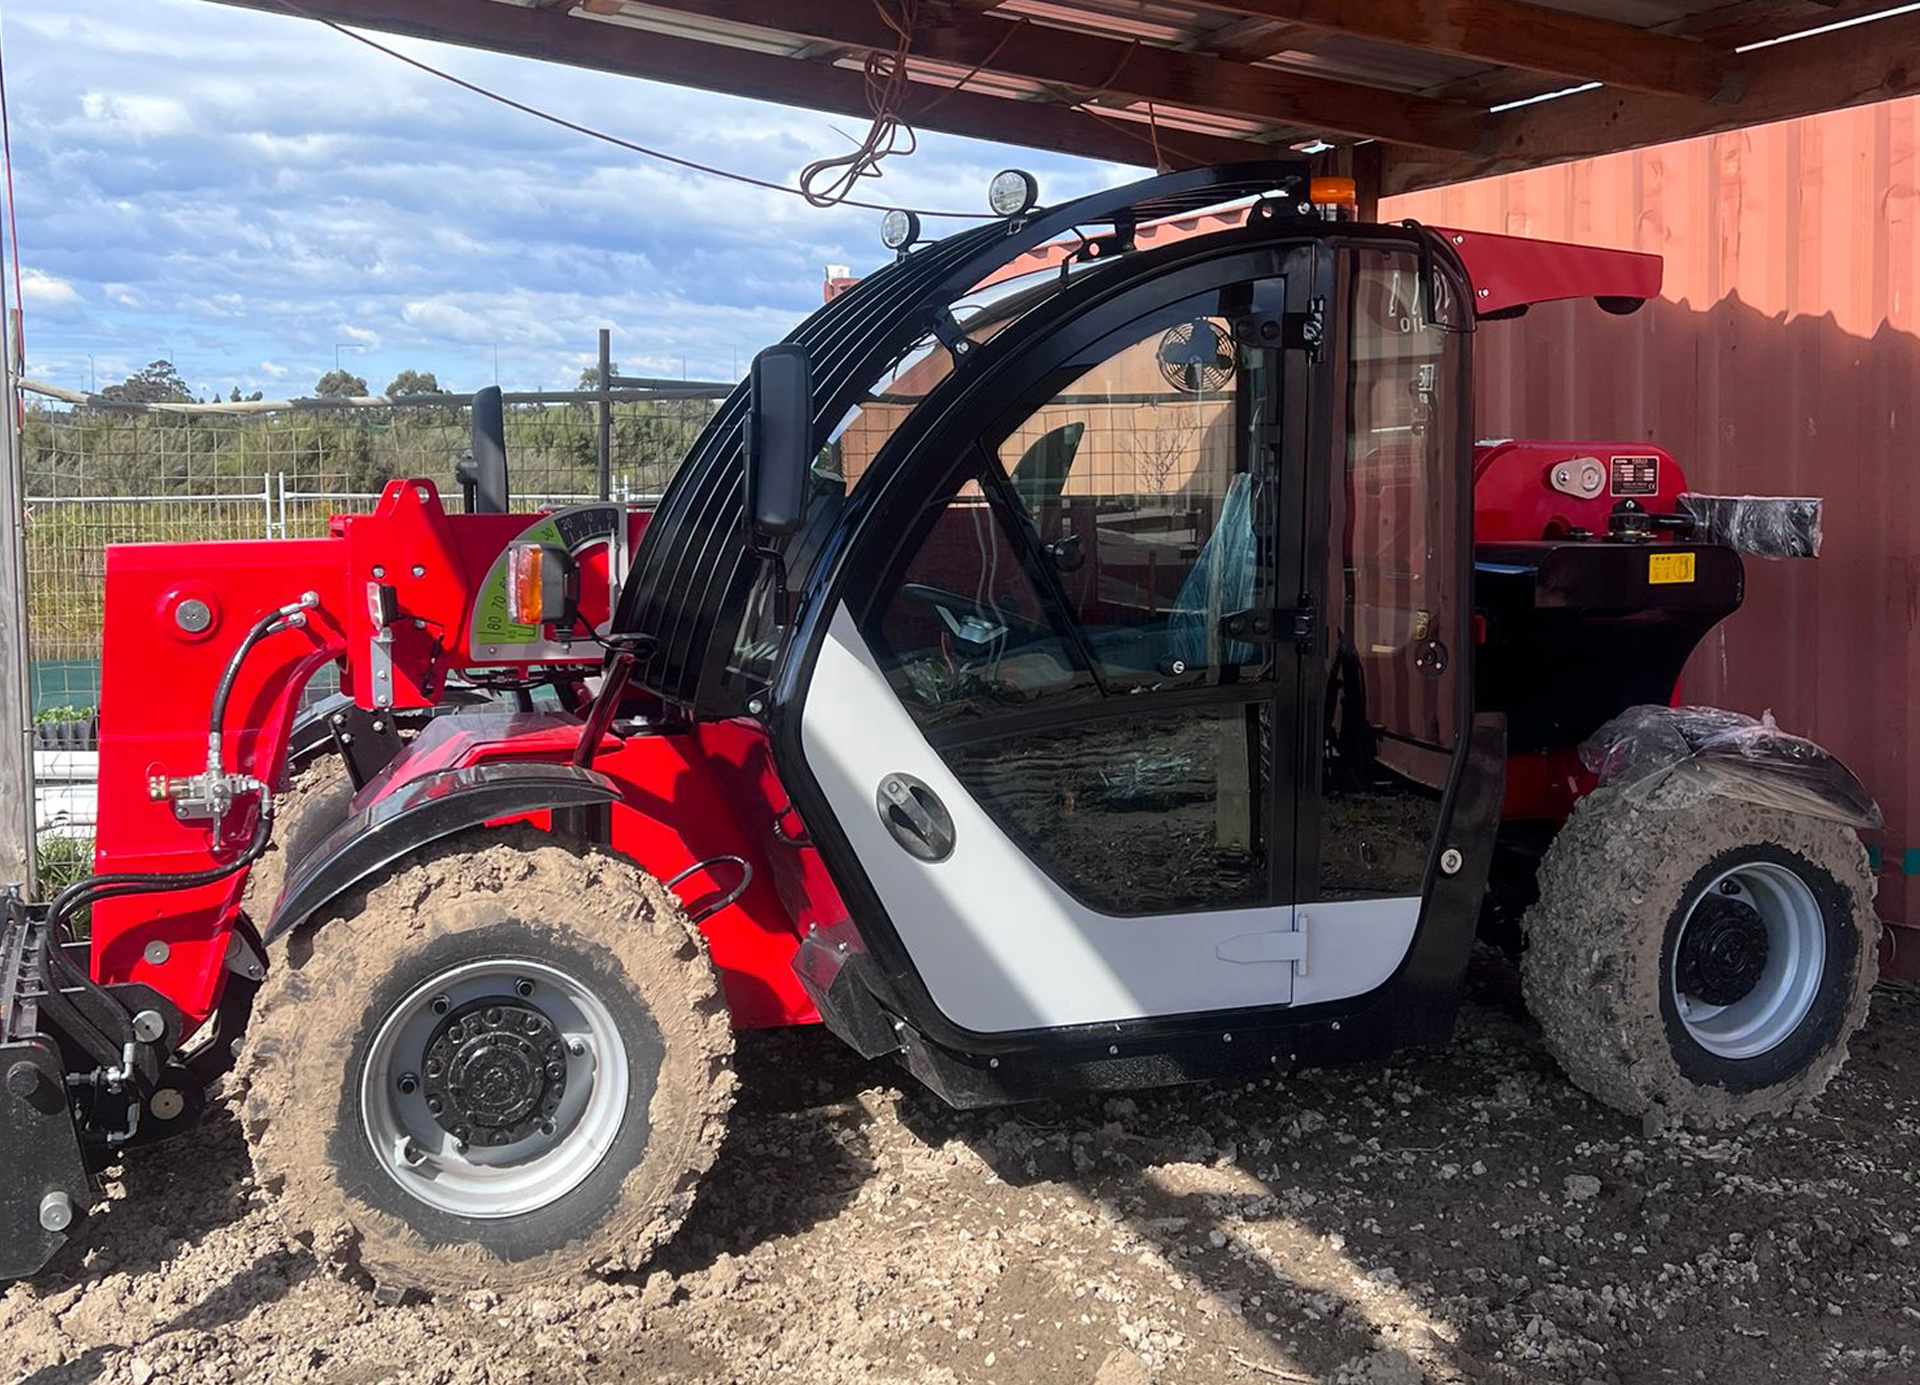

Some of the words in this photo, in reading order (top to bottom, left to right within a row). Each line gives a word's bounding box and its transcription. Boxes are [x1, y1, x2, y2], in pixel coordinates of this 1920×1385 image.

[583, 511, 593, 522] 10
[562, 518, 574, 530] 20
[491, 595, 507, 610] 70
[487, 616, 502, 630] 80
